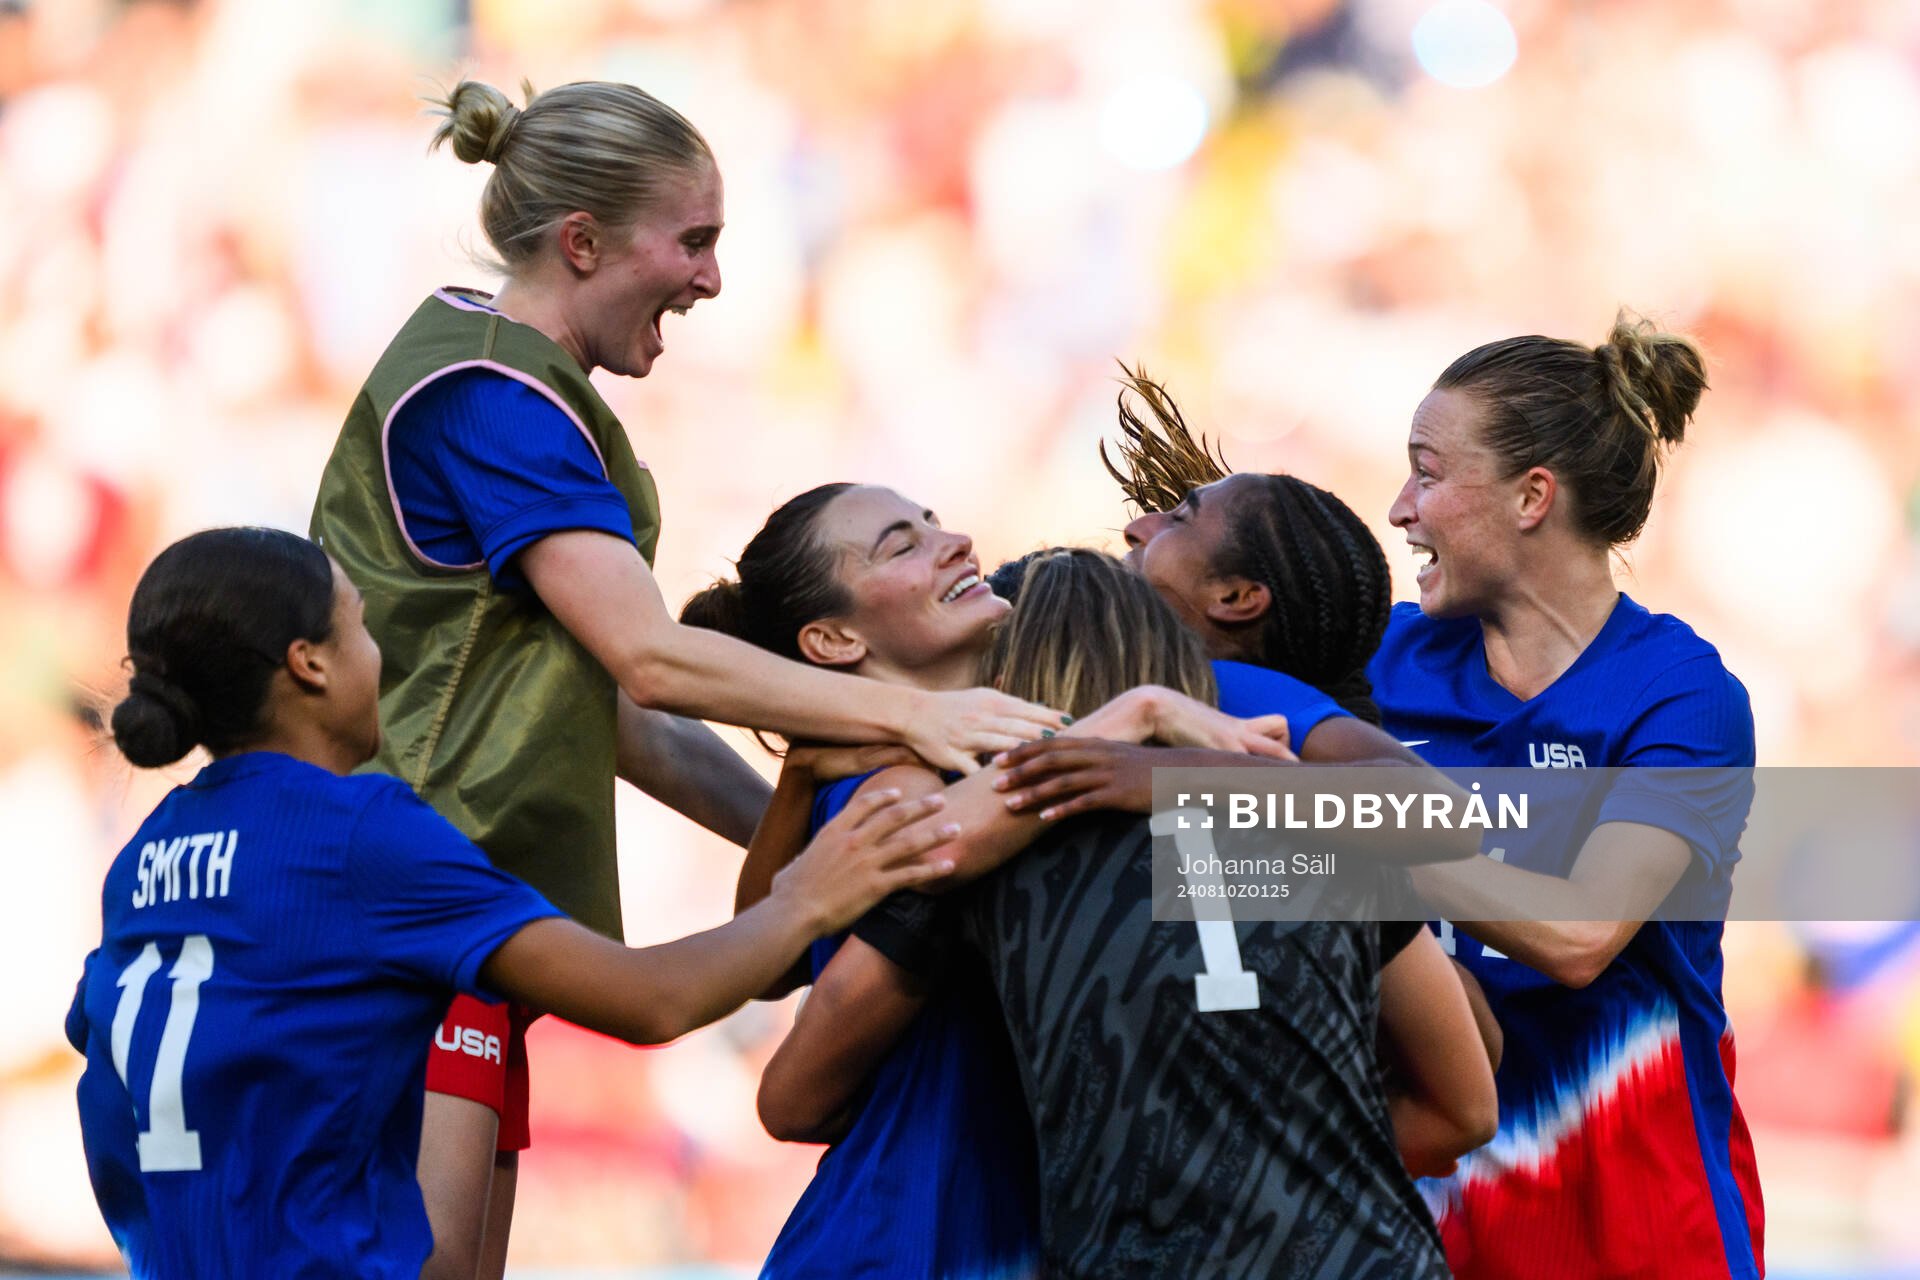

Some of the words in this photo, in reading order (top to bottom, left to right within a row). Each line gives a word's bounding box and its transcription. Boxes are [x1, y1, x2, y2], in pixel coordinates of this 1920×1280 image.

[1528, 743, 1587, 770] USA
[132, 829, 238, 909] SMITH
[1150, 807, 1260, 1012] 1
[111, 935, 214, 1172] 11
[435, 1023, 500, 1065] USA
